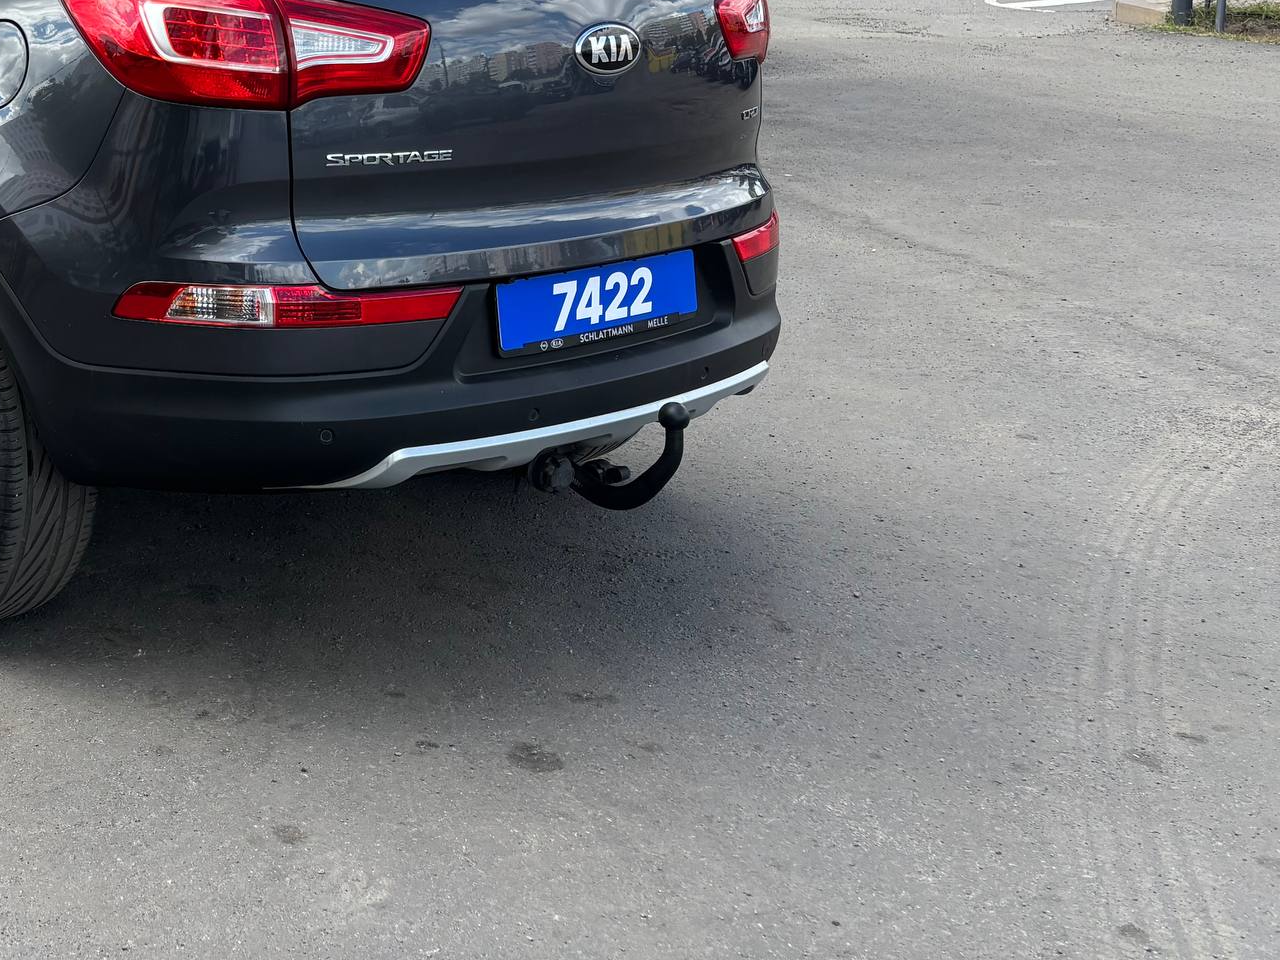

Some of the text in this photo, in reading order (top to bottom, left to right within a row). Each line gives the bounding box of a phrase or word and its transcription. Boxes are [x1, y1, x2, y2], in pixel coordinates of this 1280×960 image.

[588, 35, 634, 63] KIA
[326, 149, 453, 166] SPORTAGE
[552, 266, 653, 332] 7422
[579, 324, 634, 343] SCHLATTMANN
[647, 316, 669, 329] MELLE
